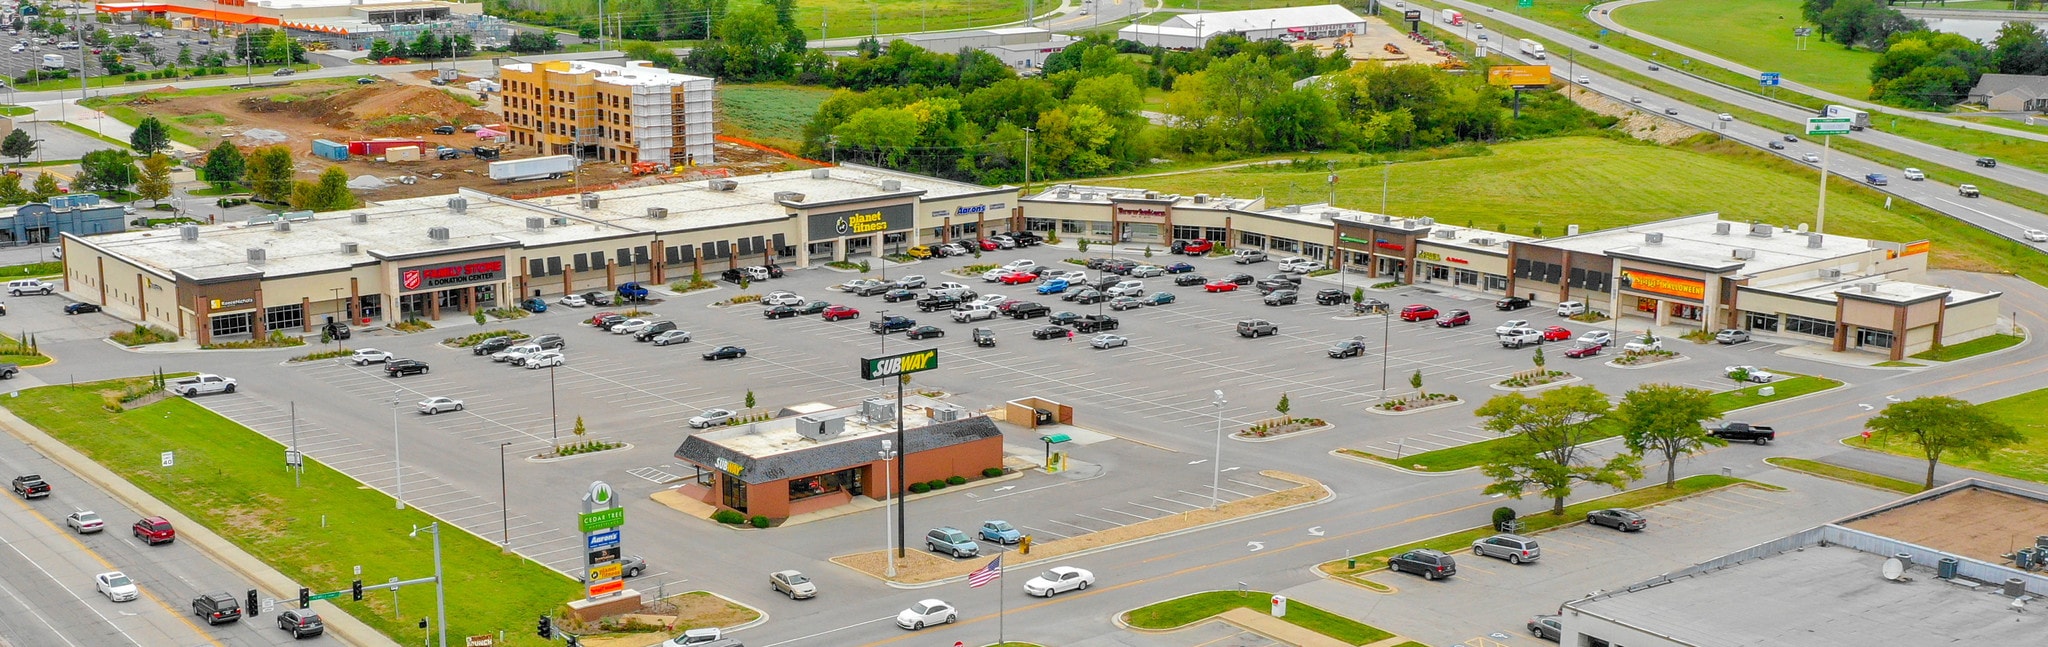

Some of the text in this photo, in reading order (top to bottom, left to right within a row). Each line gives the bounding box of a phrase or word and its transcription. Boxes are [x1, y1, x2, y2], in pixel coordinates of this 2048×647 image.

[848, 210, 881, 227] planet
[853, 220, 888, 233] fitness
[423, 260, 502, 280] FAMILY STORE
[434, 276, 467, 286] DONATION
[468, 272, 494, 282] CENTER
[872, 350, 934, 377] SUBWAY
[714, 456, 744, 476] SUBWAY
[583, 510, 623, 525] CEDAR TREE
[590, 533, 618, 545] Aaron's
[599, 565, 618, 574] planet
[601, 570, 621, 580] fitness
